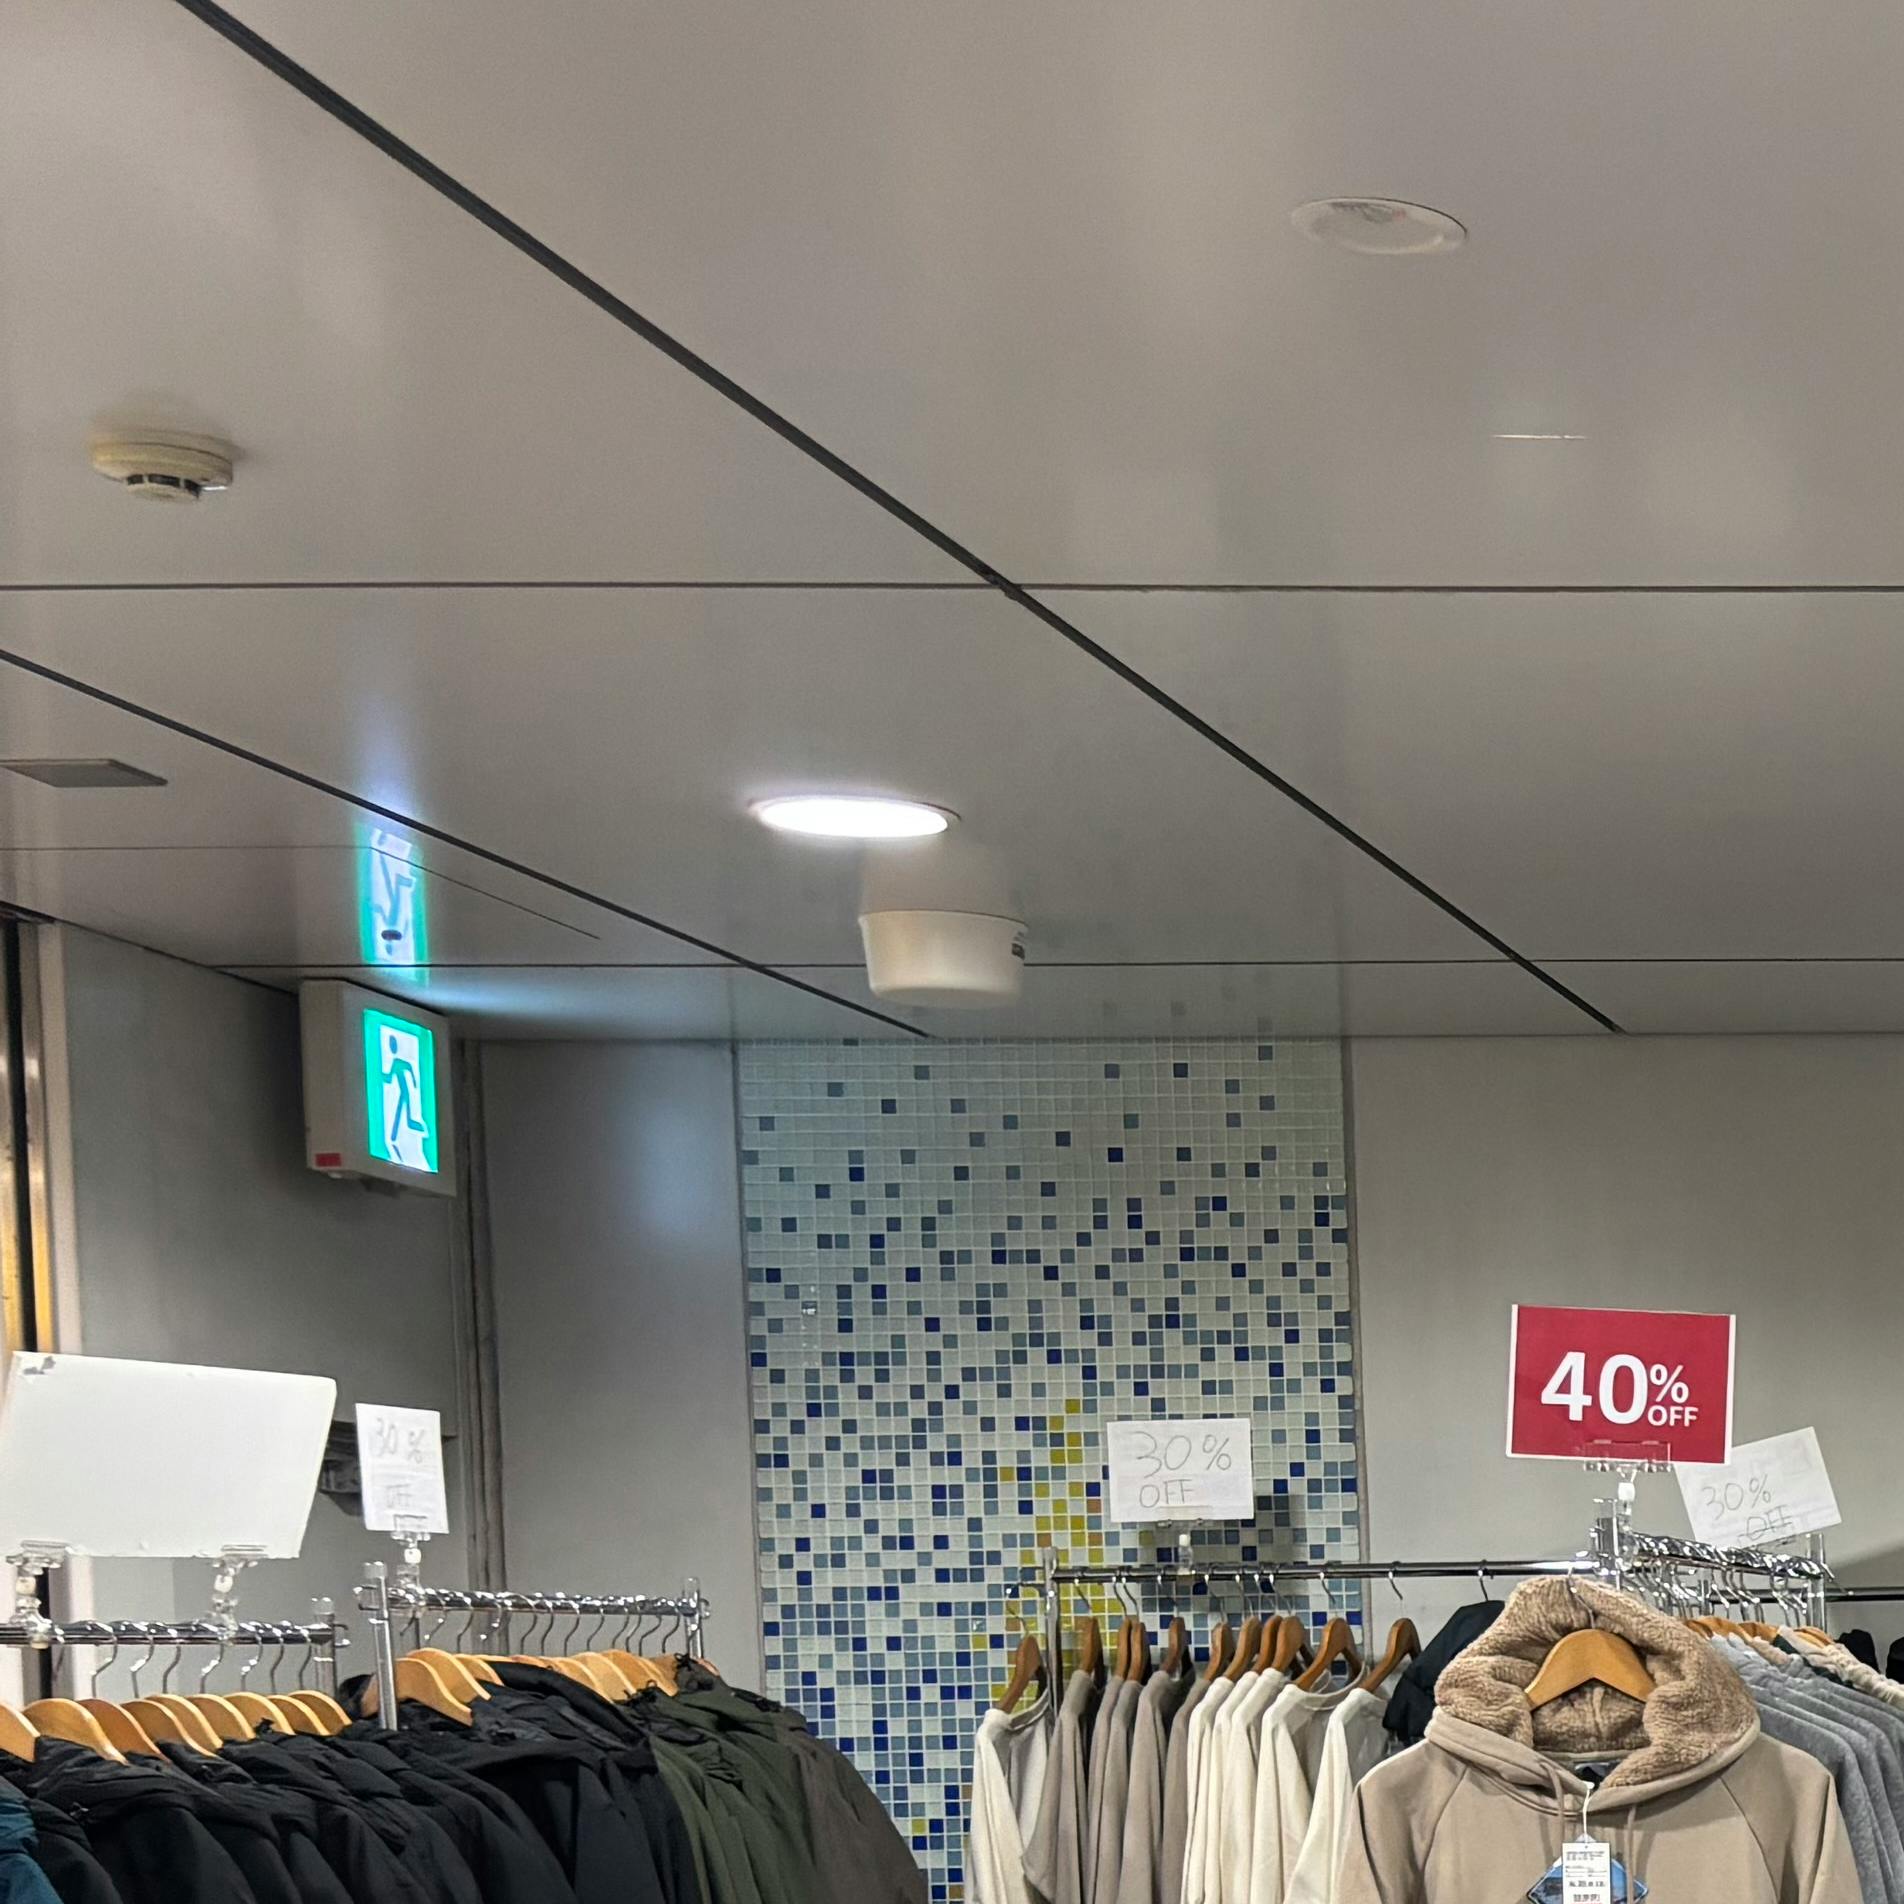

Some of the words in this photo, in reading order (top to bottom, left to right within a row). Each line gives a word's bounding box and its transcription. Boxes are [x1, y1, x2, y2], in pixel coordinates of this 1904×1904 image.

[1540, 1351, 1690, 1425] 40%
[1647, 1404, 1699, 1428] OFF
[1138, 1478, 1195, 1509] OFF
[1744, 1503, 1792, 1542] OFF
